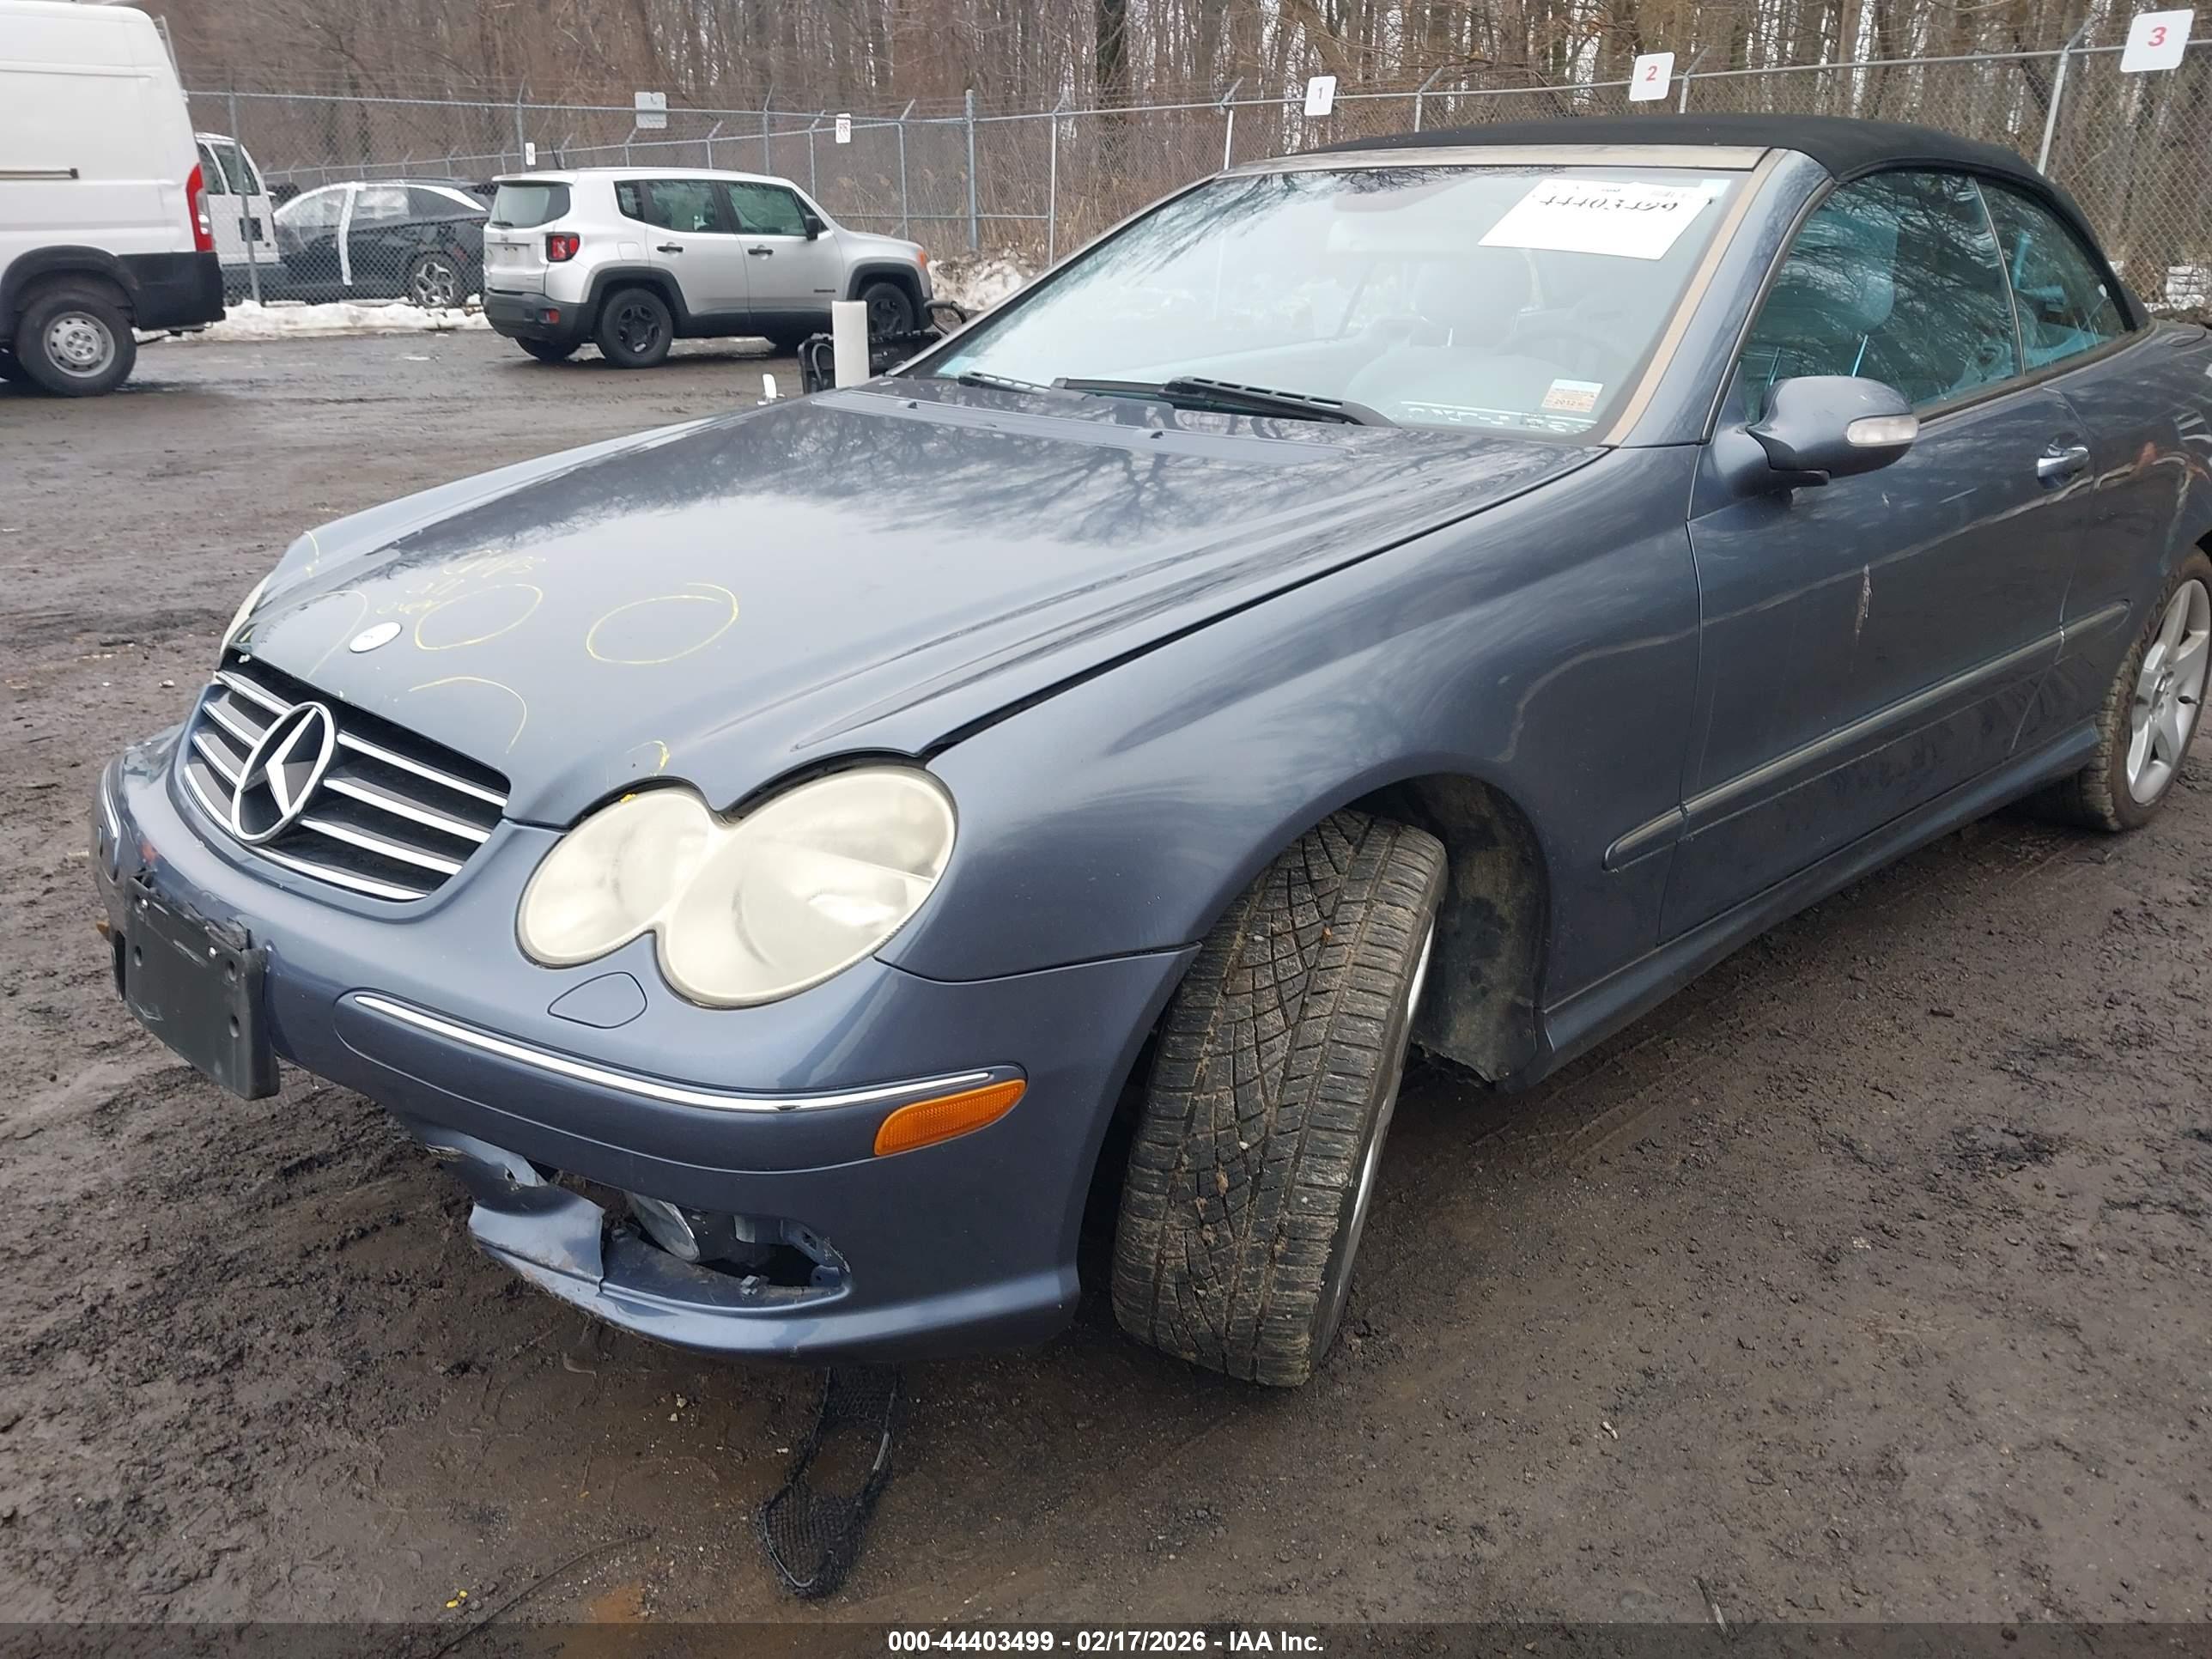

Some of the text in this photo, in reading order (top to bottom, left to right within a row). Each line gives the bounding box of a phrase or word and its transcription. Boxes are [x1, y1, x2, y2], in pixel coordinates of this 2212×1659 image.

[2148, 27, 2166, 47] 3
[1645, 65, 1658, 82] 2
[1318, 86, 1323, 100] 1
